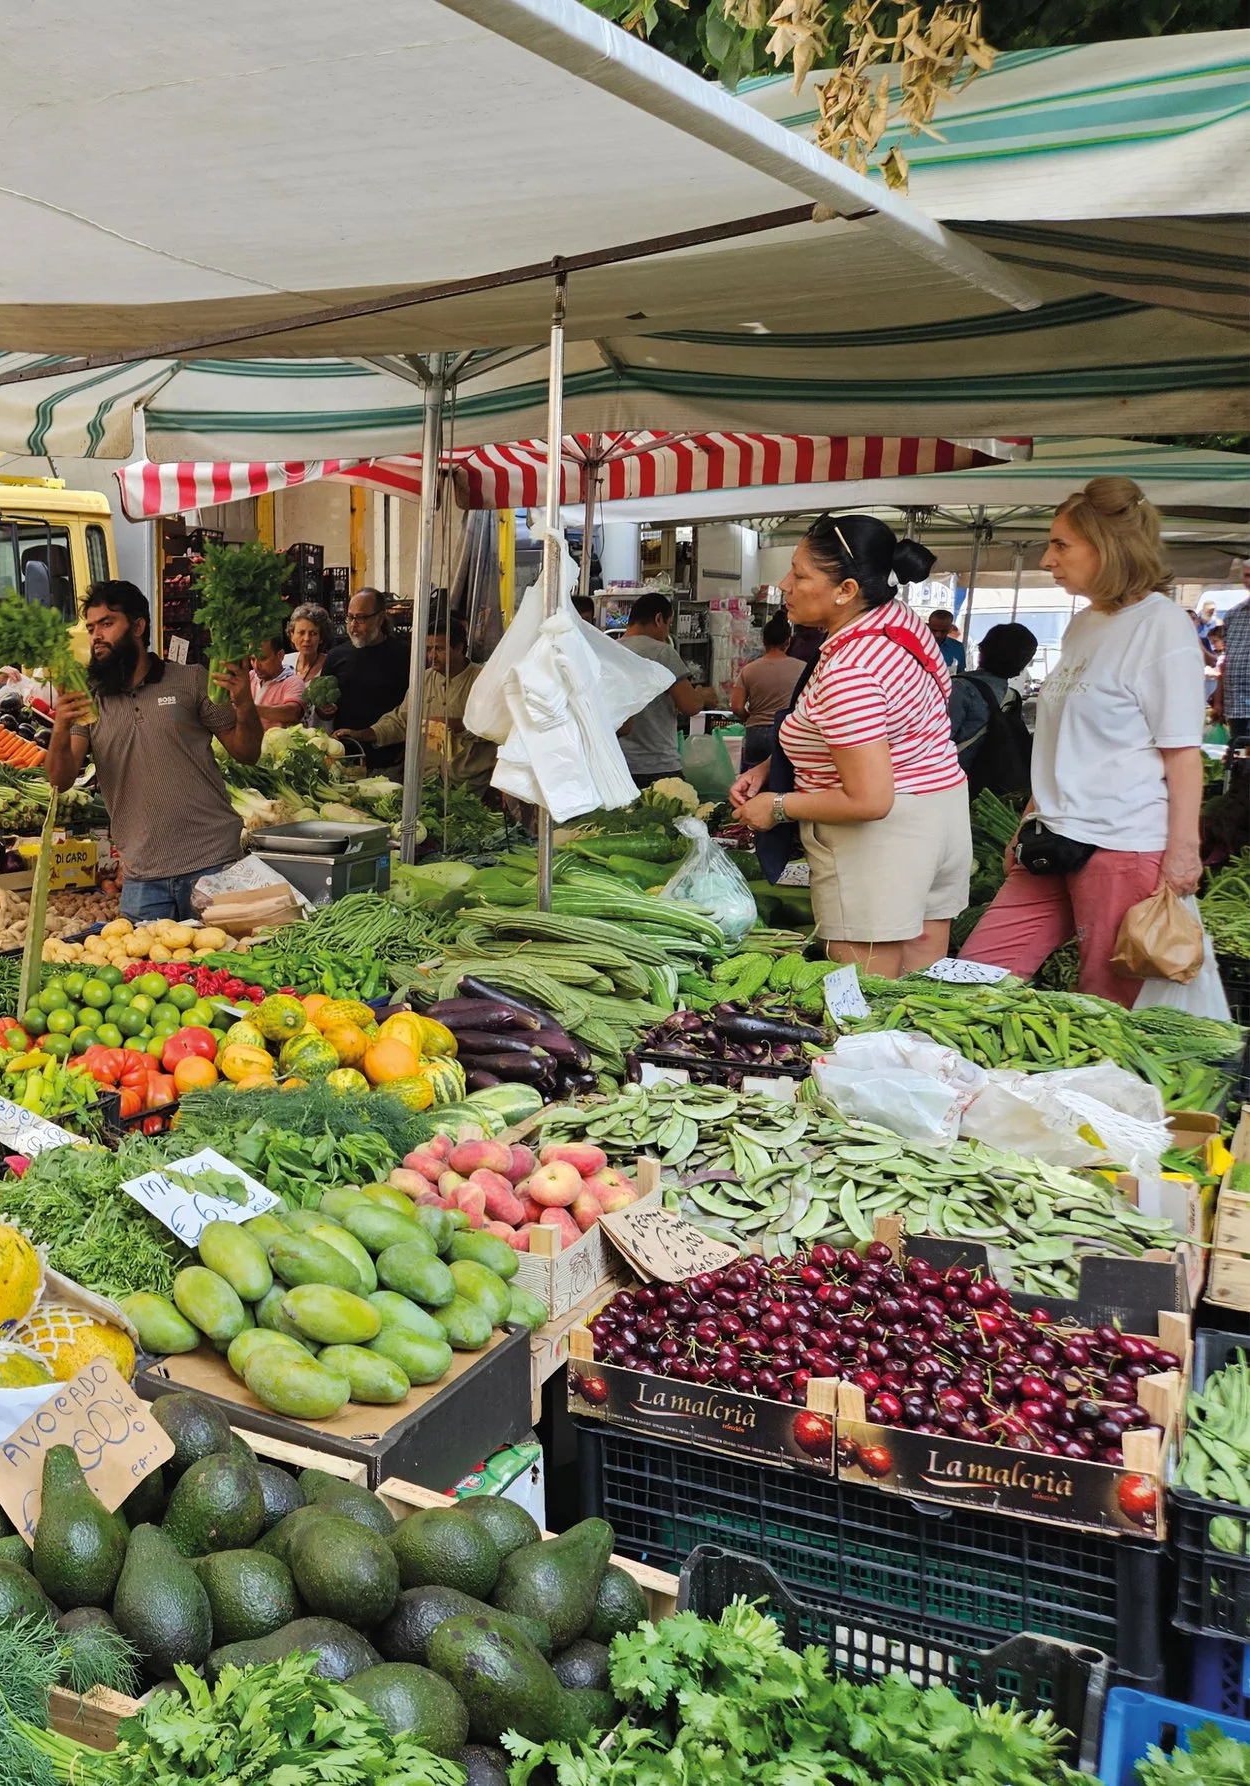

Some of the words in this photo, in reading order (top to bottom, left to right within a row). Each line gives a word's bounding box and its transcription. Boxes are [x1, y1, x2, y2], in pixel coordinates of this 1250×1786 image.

[157, 696, 177, 704] BOSS
[2, 1365, 108, 1468] AVOCADO
[636, 1382, 667, 1408] La
[670, 1394, 757, 1429] malcrià
[925, 1449, 964, 1477] La
[967, 1460, 1074, 1497] malcrià
